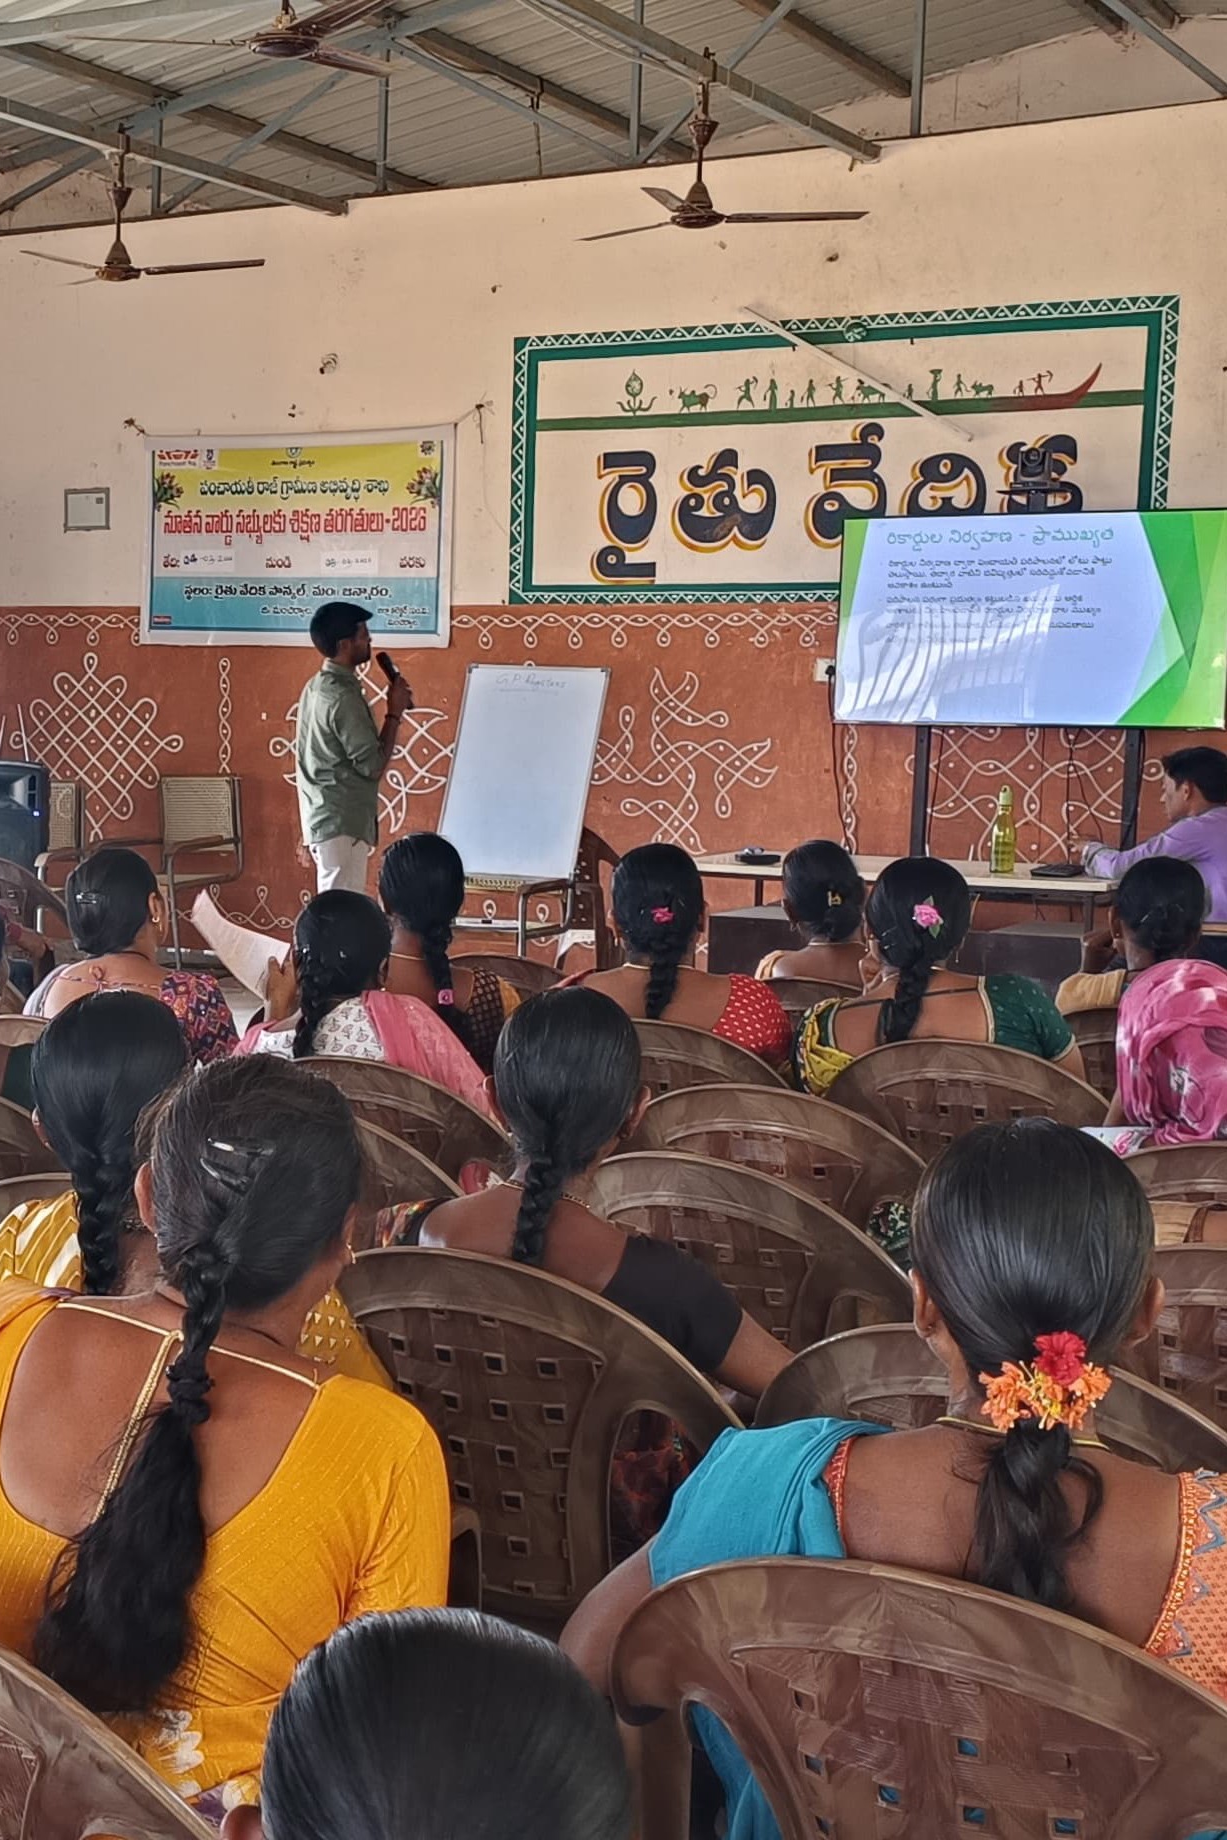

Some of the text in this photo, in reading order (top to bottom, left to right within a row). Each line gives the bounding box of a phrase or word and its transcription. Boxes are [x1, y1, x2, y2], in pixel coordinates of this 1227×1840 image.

[364, 479, 389, 496] శాఖ
[164, 510, 202, 534] నూతన
[205, 509, 233, 545] వార్డు
[236, 509, 286, 544] సభ్యులకు
[289, 508, 321, 543] శిక్షణ
[591, 448, 776, 585] రైతు
[887, 530, 943, 551] రికార్డుల
[949, 528, 1012, 550] నిర్వహణ
[1032, 525, 1114, 548] ప్రాముఖ్యత
[214, 584, 237, 599] రైతు
[239, 583, 266, 596] వేదిక
